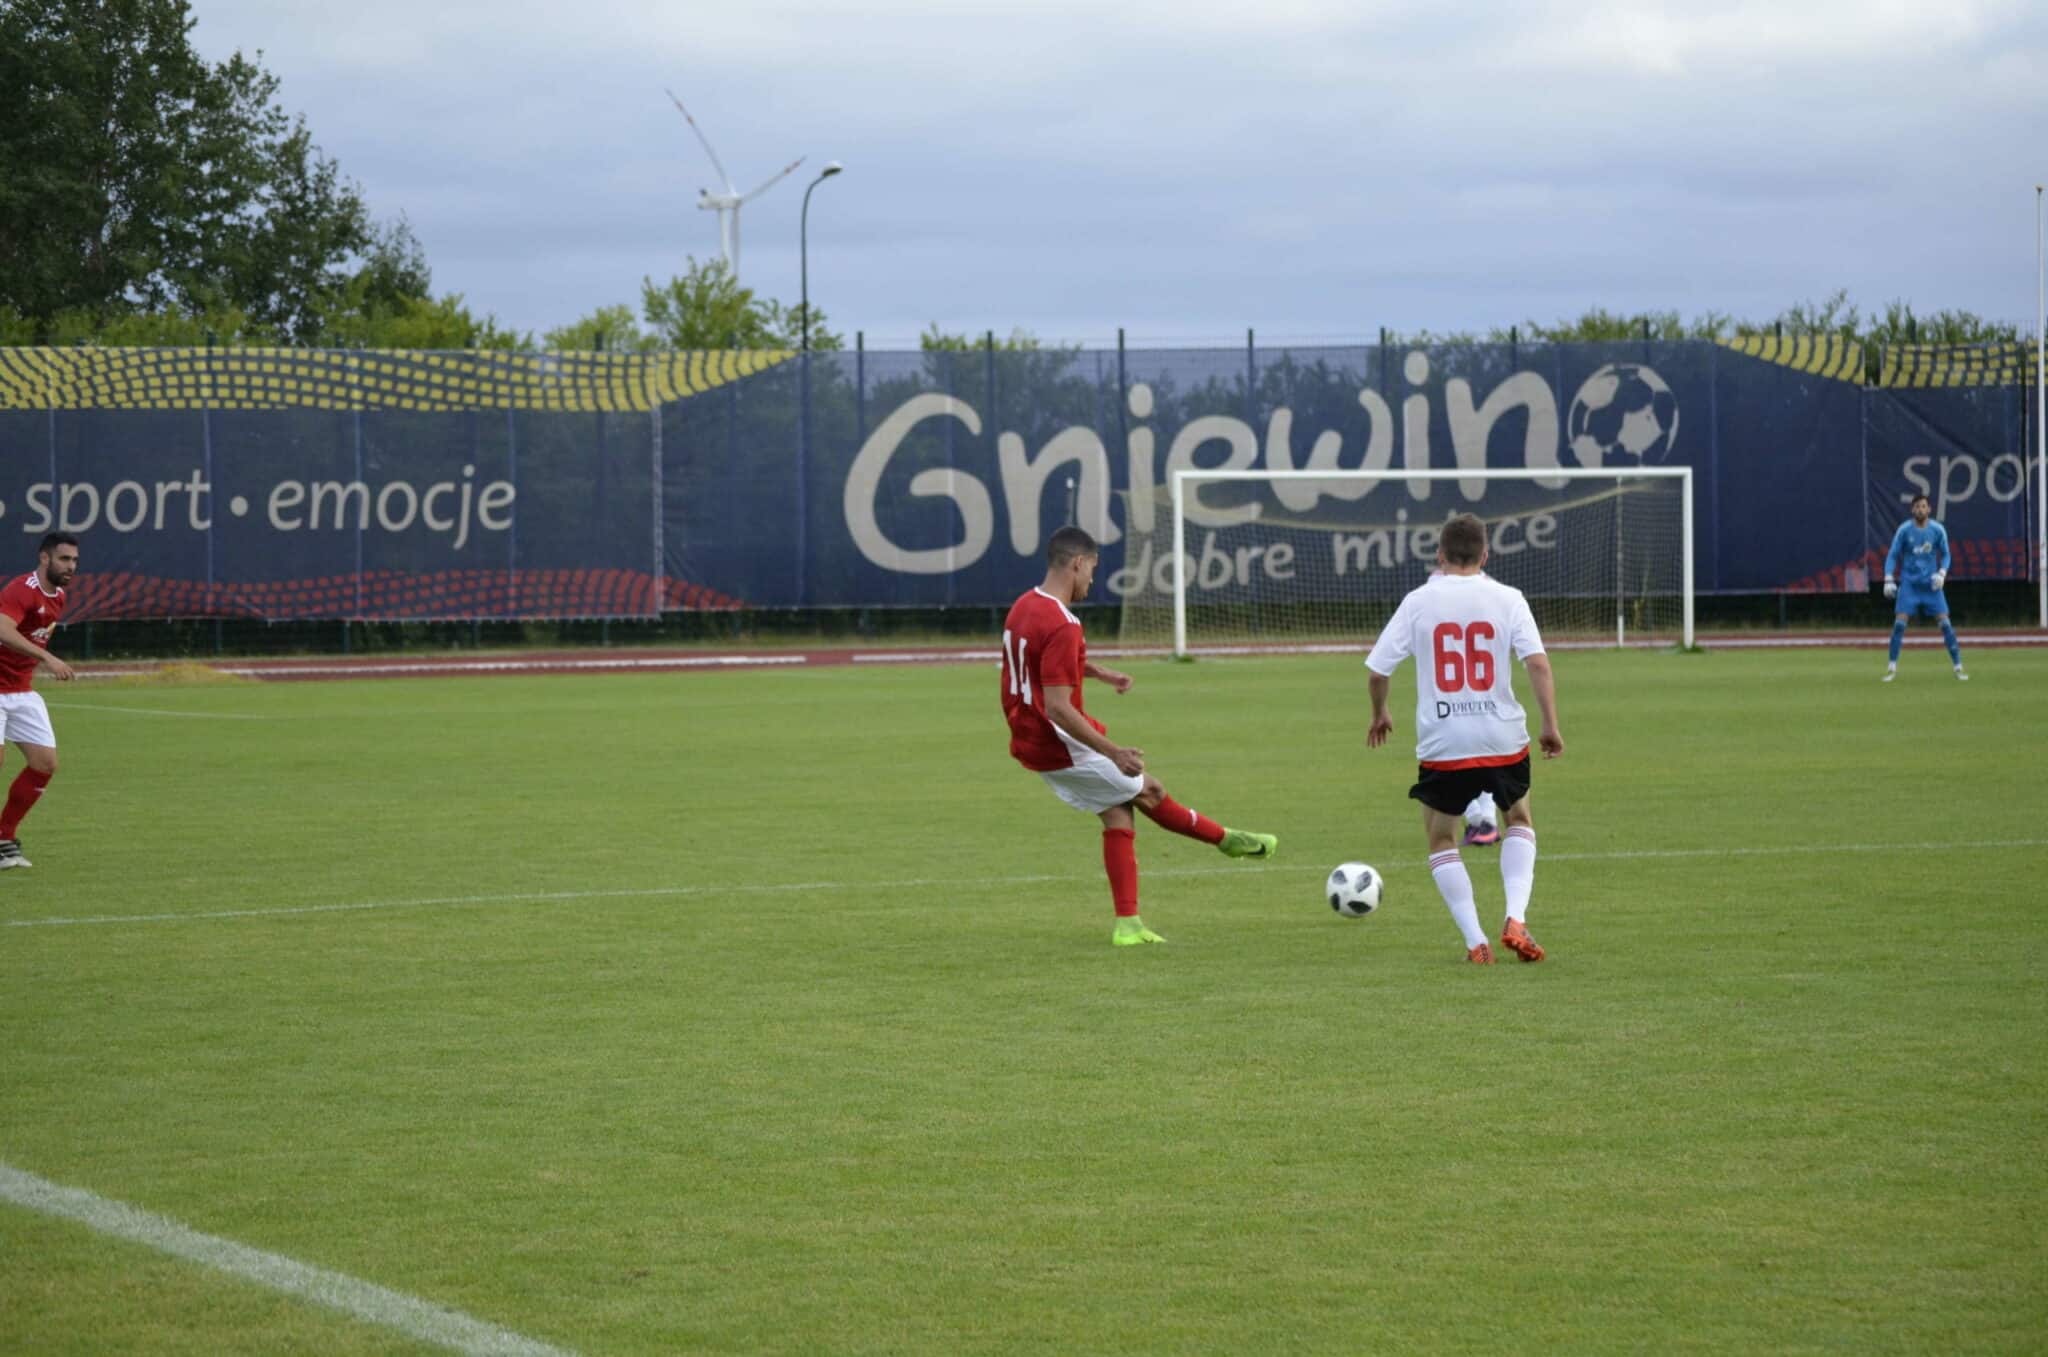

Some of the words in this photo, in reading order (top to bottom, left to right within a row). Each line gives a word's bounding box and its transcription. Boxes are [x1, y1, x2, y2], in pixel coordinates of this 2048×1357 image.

[23, 469, 212, 533] sport
[268, 464, 517, 550] emocje
[1106, 531, 1296, 596] dobre
[1333, 508, 1558, 577] miece
[1003, 629, 1032, 705] 14
[1433, 621, 1494, 693] 66
